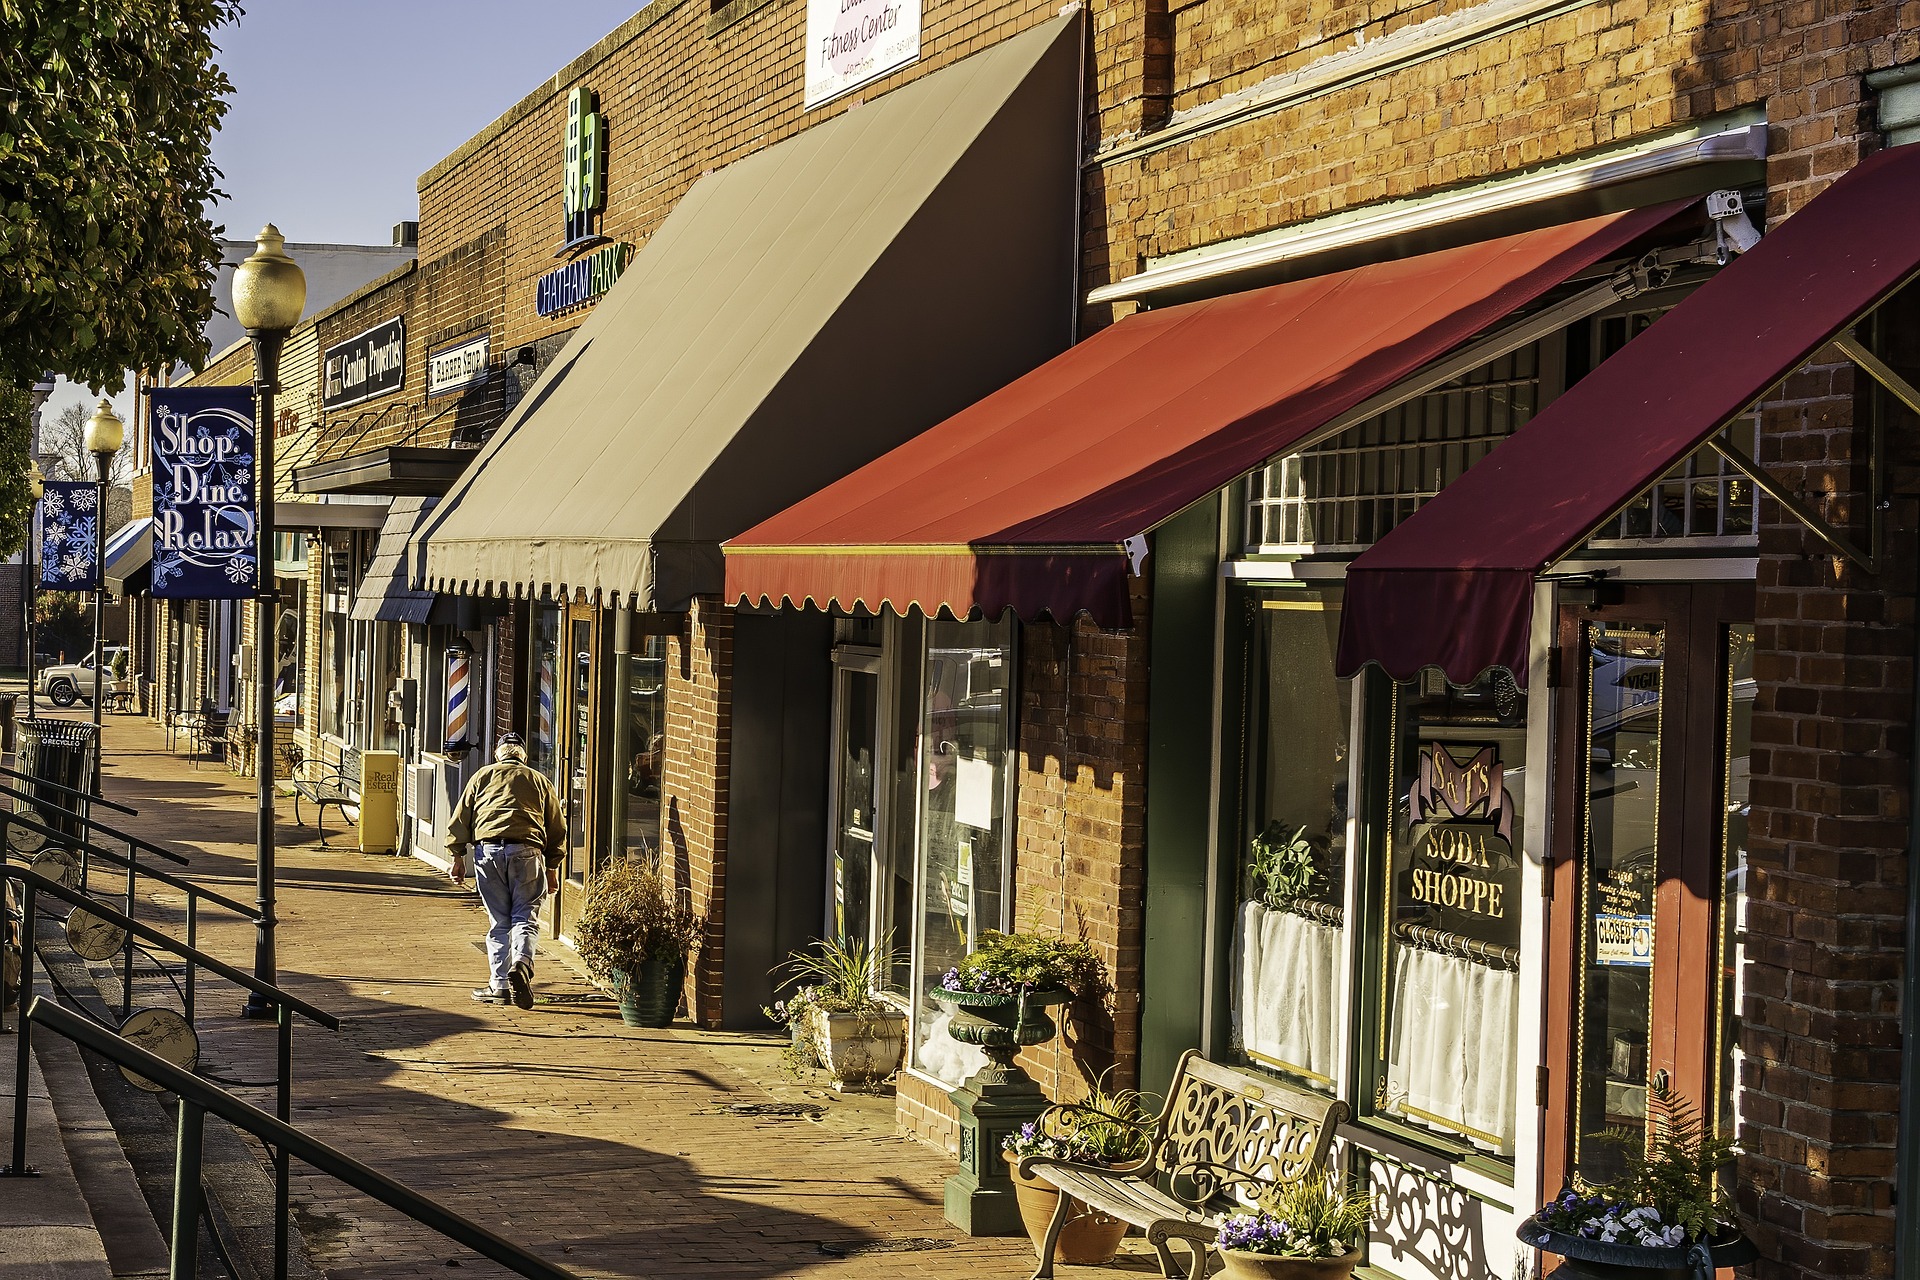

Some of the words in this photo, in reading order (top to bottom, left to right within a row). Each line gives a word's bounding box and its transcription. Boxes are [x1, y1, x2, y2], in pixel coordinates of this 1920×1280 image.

[822, 27, 859, 68] Fitness
[861, 4, 902, 43] Center
[342, 349, 367, 389] Carolina
[368, 331, 400, 381] Properties
[436, 356, 462, 383] BARBER
[463, 349, 481, 377] SHOP
[161, 413, 239, 463] Shop.
[171, 463, 248, 505] Dine.
[162, 509, 254, 550] Relax.
[366, 780, 397, 790] Estate
[374, 771, 395, 782] Real
[1426, 827, 1490, 868] SODA
[1412, 868, 1504, 919] SHOPPE
[1598, 921, 1631, 945] CLOSED
